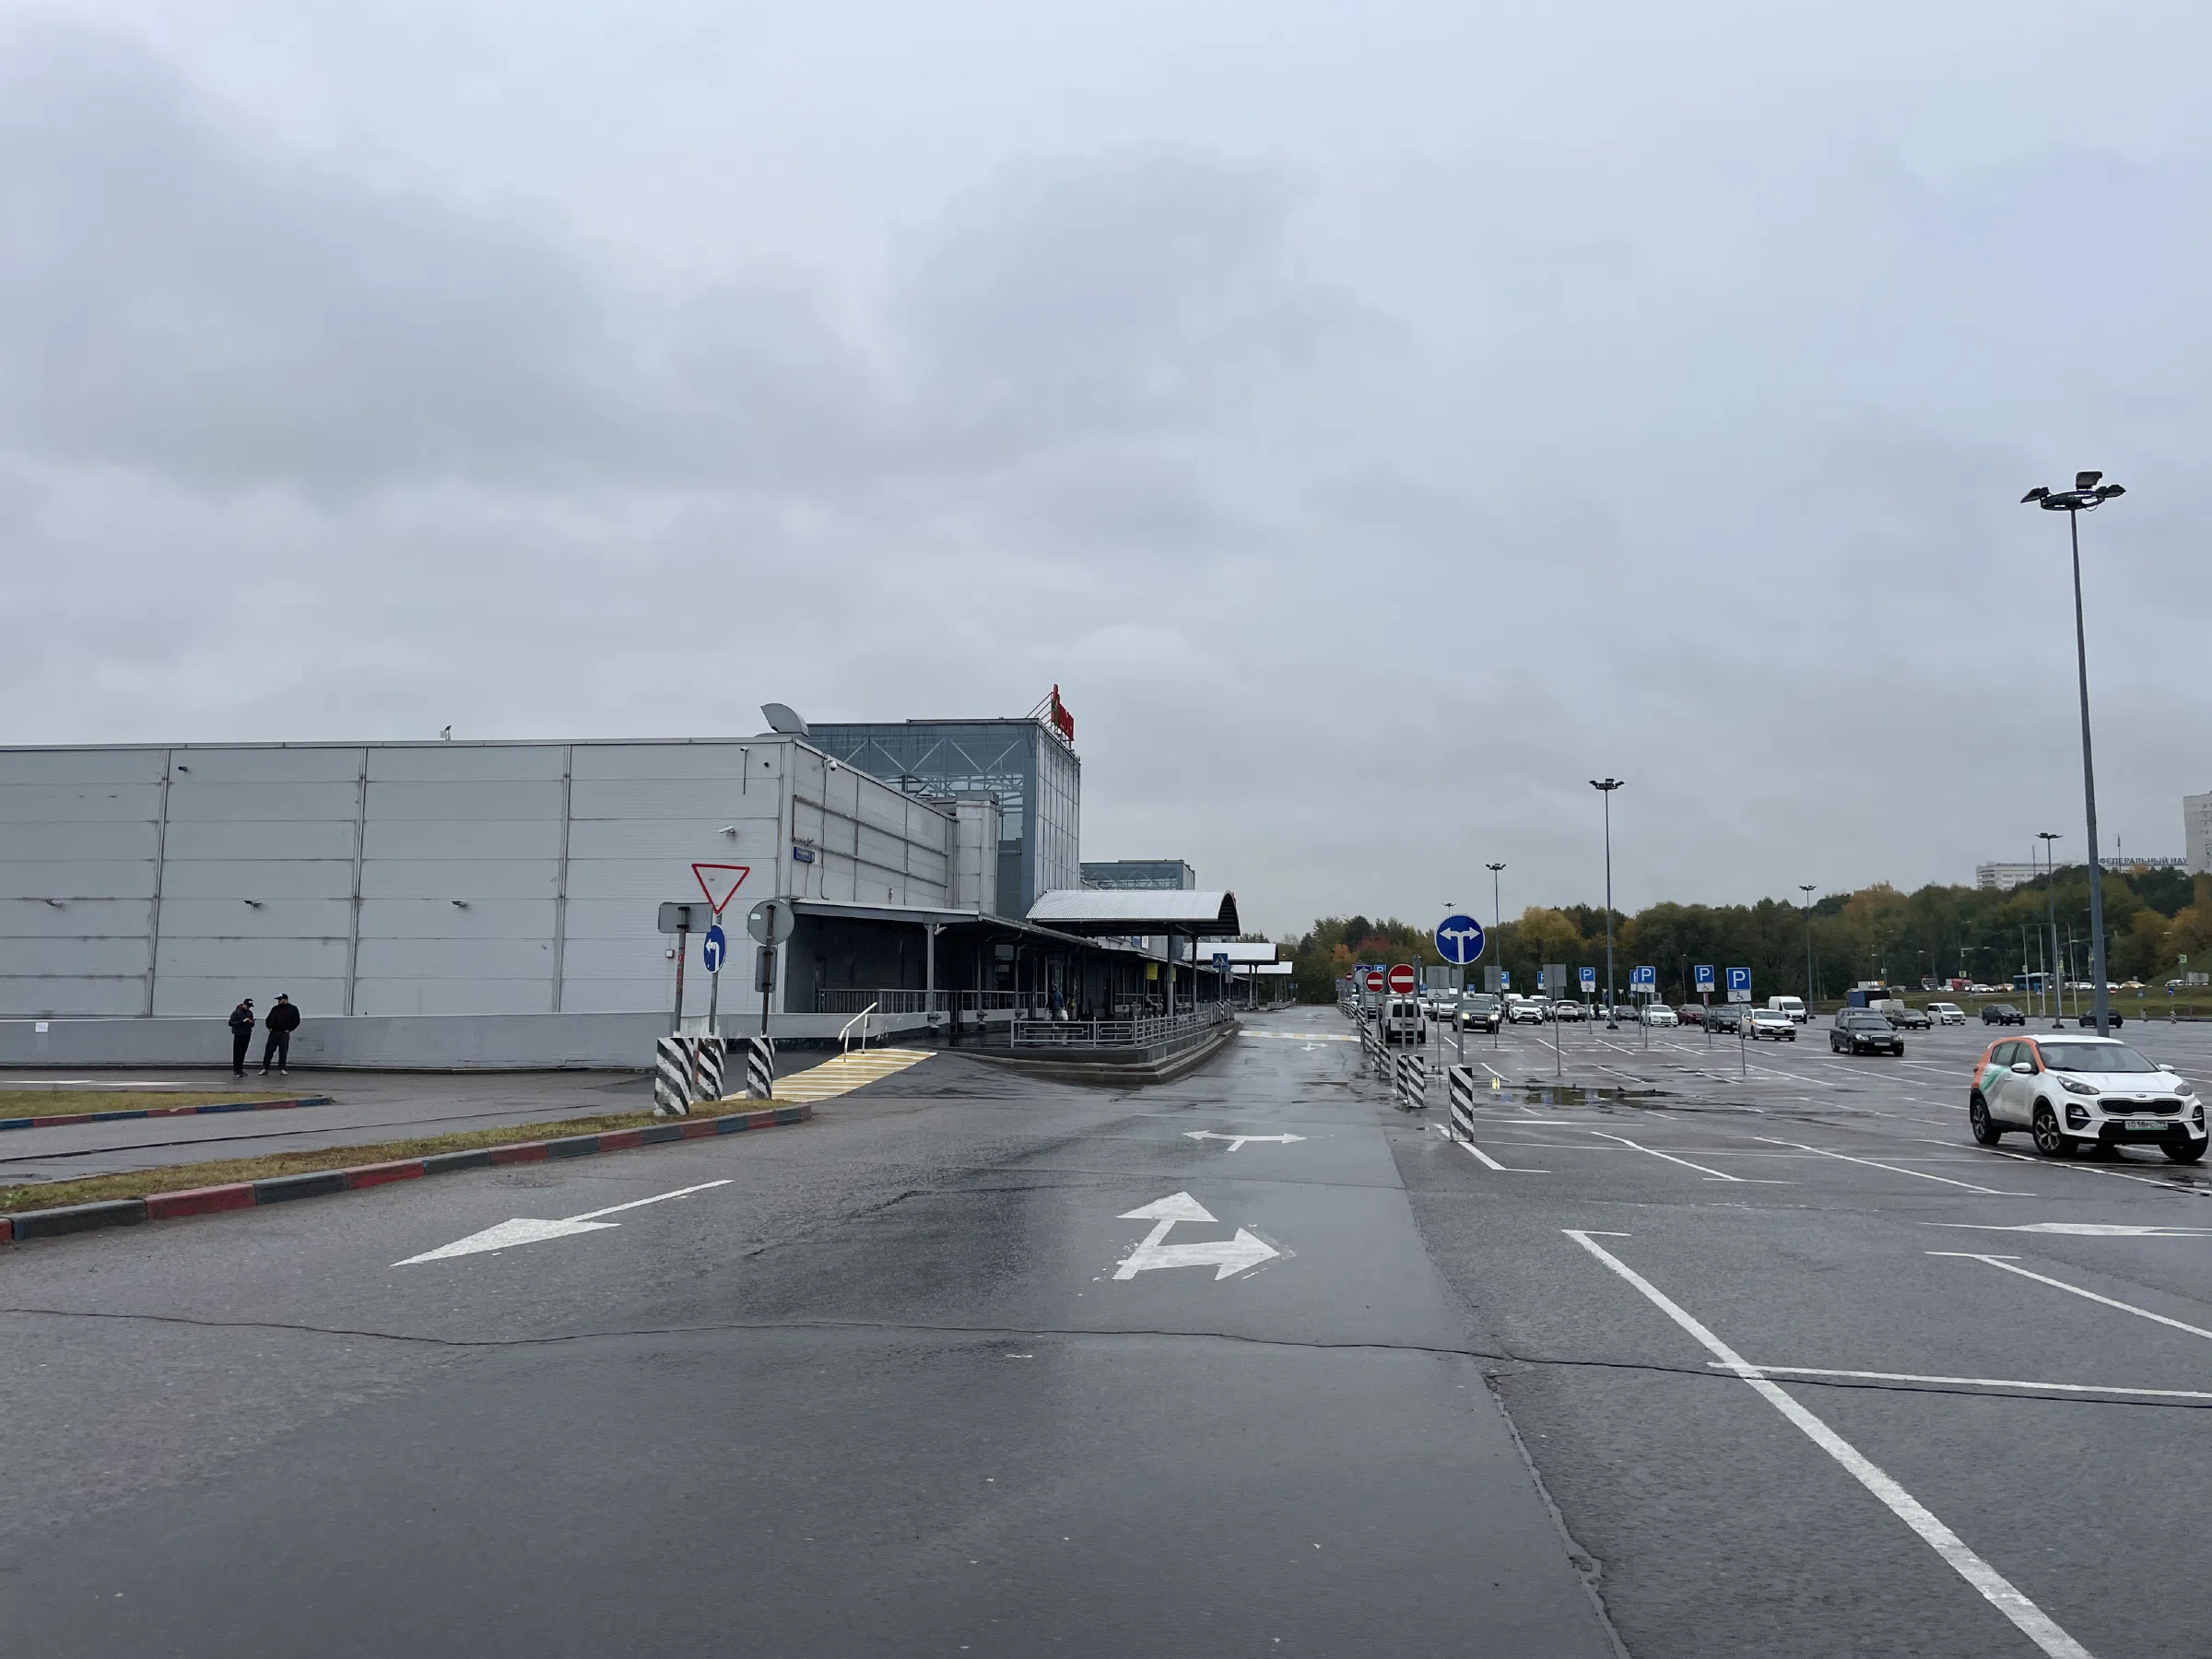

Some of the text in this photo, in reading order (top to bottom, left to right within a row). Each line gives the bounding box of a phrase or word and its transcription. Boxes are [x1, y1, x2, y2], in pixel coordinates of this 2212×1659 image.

[2099, 856, 2169, 865] ФЕДЕРАЛЬНЫЙ
[1583, 969, 1592, 980] P
[1641, 969, 1651, 982] P
[1700, 968, 1710, 982] P
[1733, 971, 1746, 988] P
